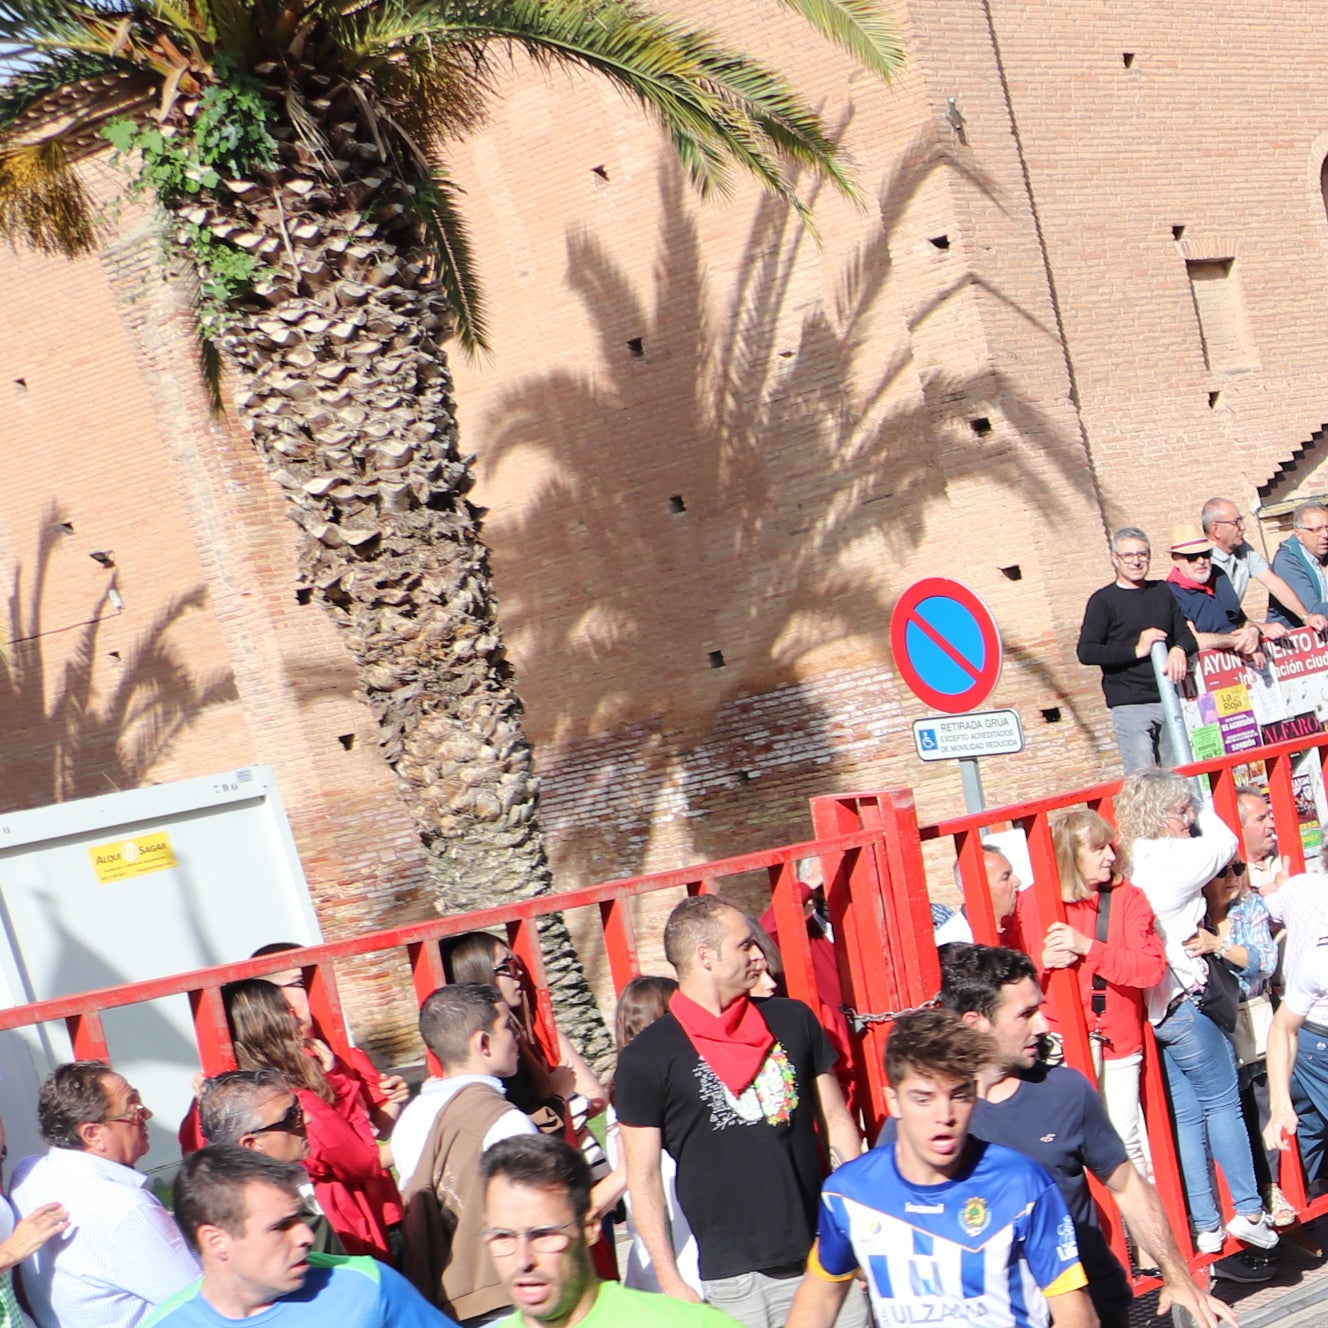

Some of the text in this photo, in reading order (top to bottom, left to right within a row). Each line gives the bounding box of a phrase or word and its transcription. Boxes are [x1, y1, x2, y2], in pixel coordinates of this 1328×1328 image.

[940, 715, 1009, 732] RETIRADA GRÚA
[940, 730, 1014, 743] EXCEPTO ACREDITADOS
[941, 739, 1018, 753] DE MOVILIDAD REDUCIDA
